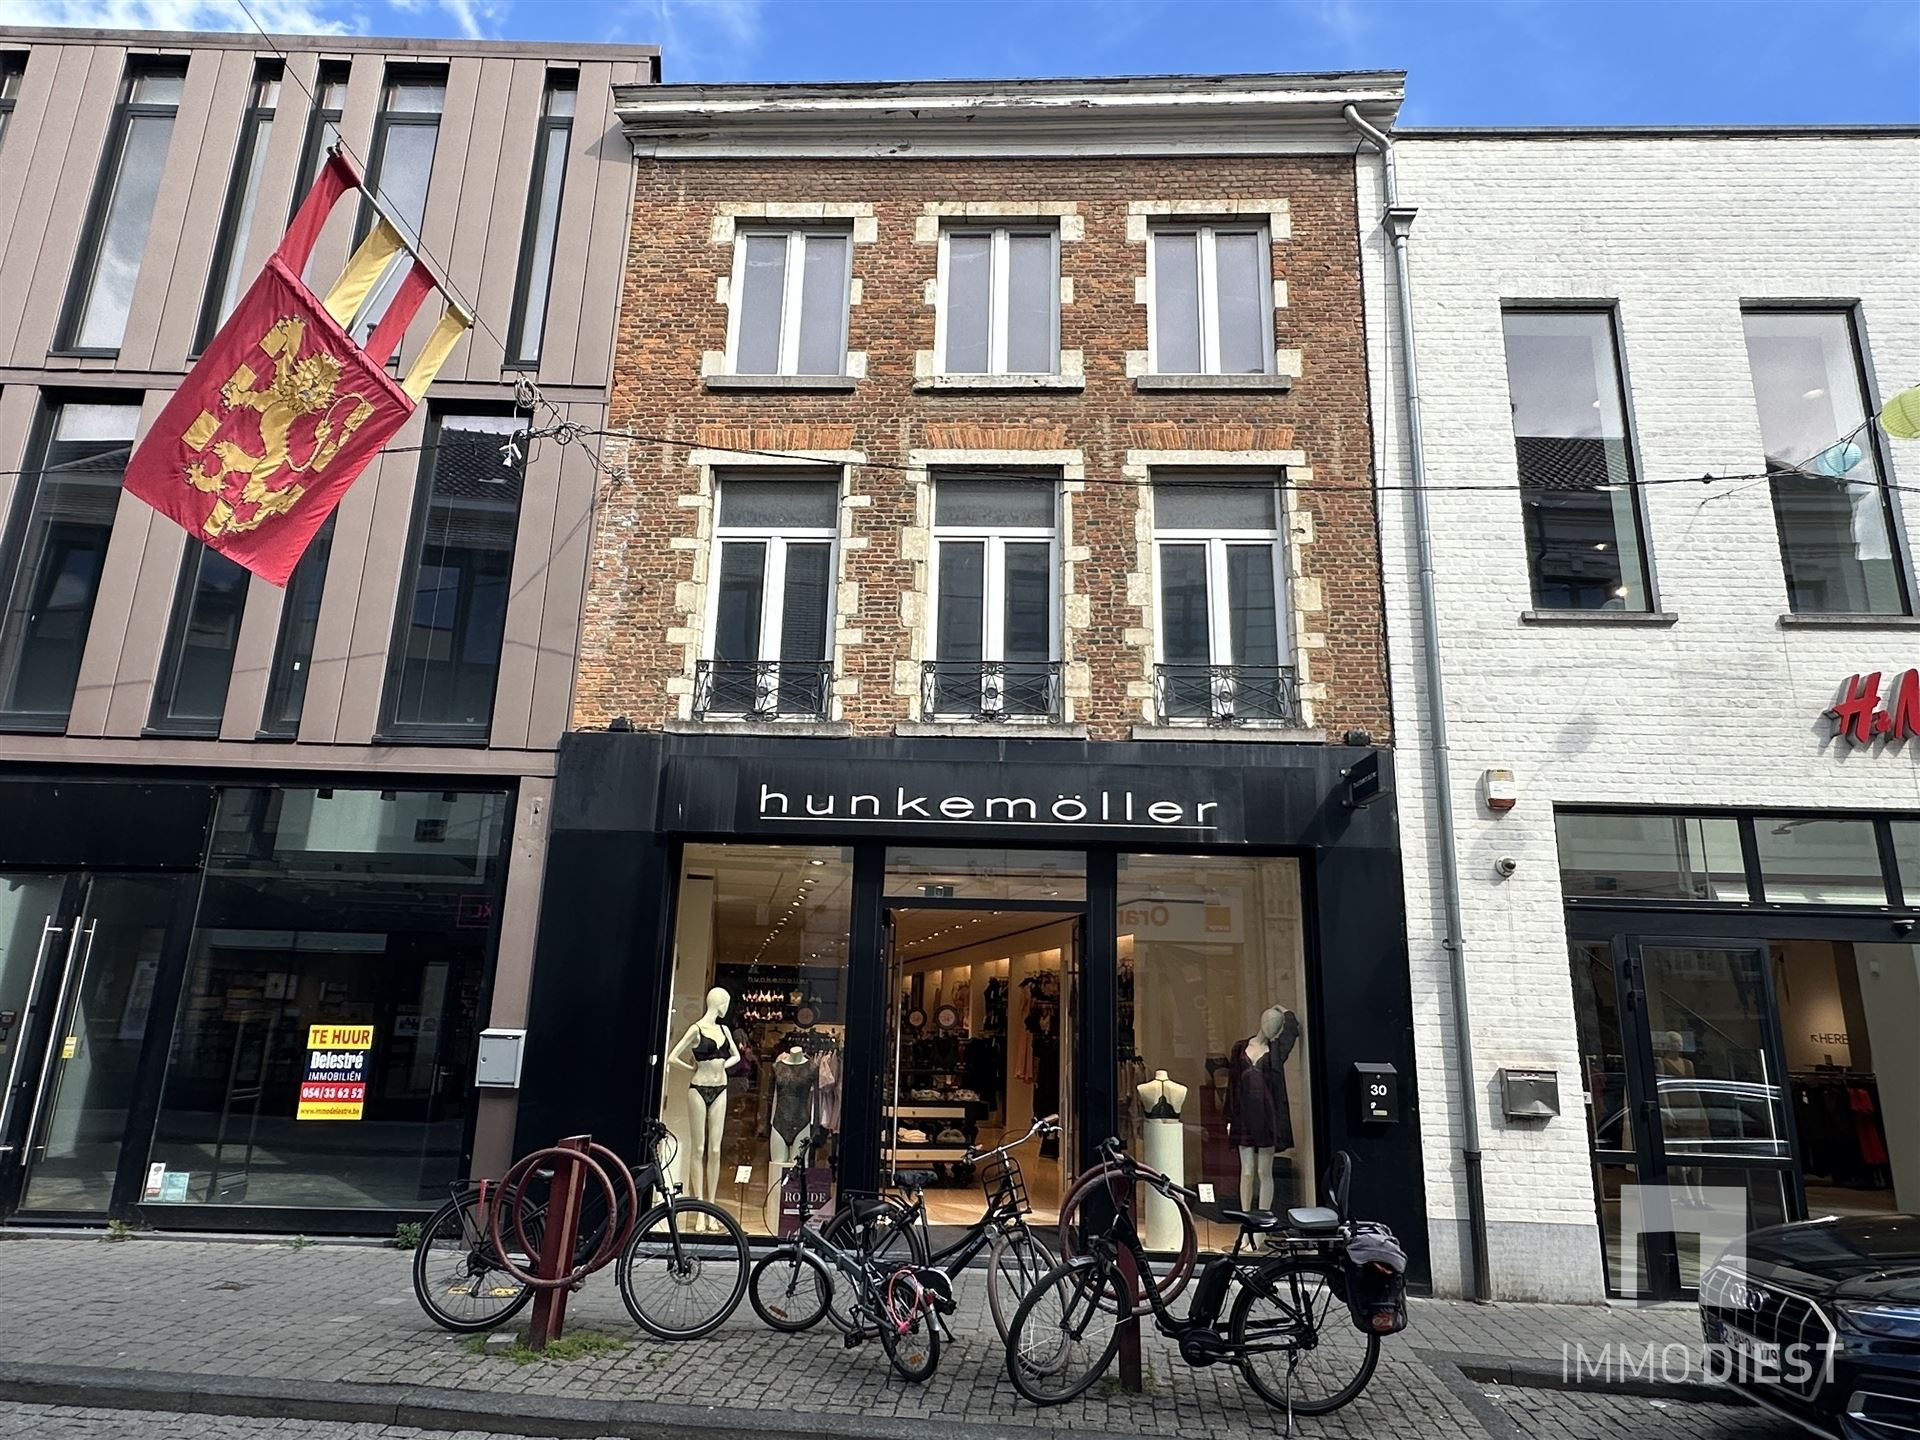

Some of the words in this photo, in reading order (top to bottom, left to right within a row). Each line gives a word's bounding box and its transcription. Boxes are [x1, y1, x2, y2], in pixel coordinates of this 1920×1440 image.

[759, 783, 1218, 823] hunkemöller
[311, 1029, 329, 1045] TE
[331, 1029, 370, 1045] HUUR
[310, 1051, 364, 1069] Delestré
[308, 1071, 361, 1082] IMMOBILIËN
[337, 1087, 350, 1099] 62
[350, 1087, 363, 1099] 52
[1370, 1084, 1387, 1096] 30
[784, 1191, 827, 1203] RODE
